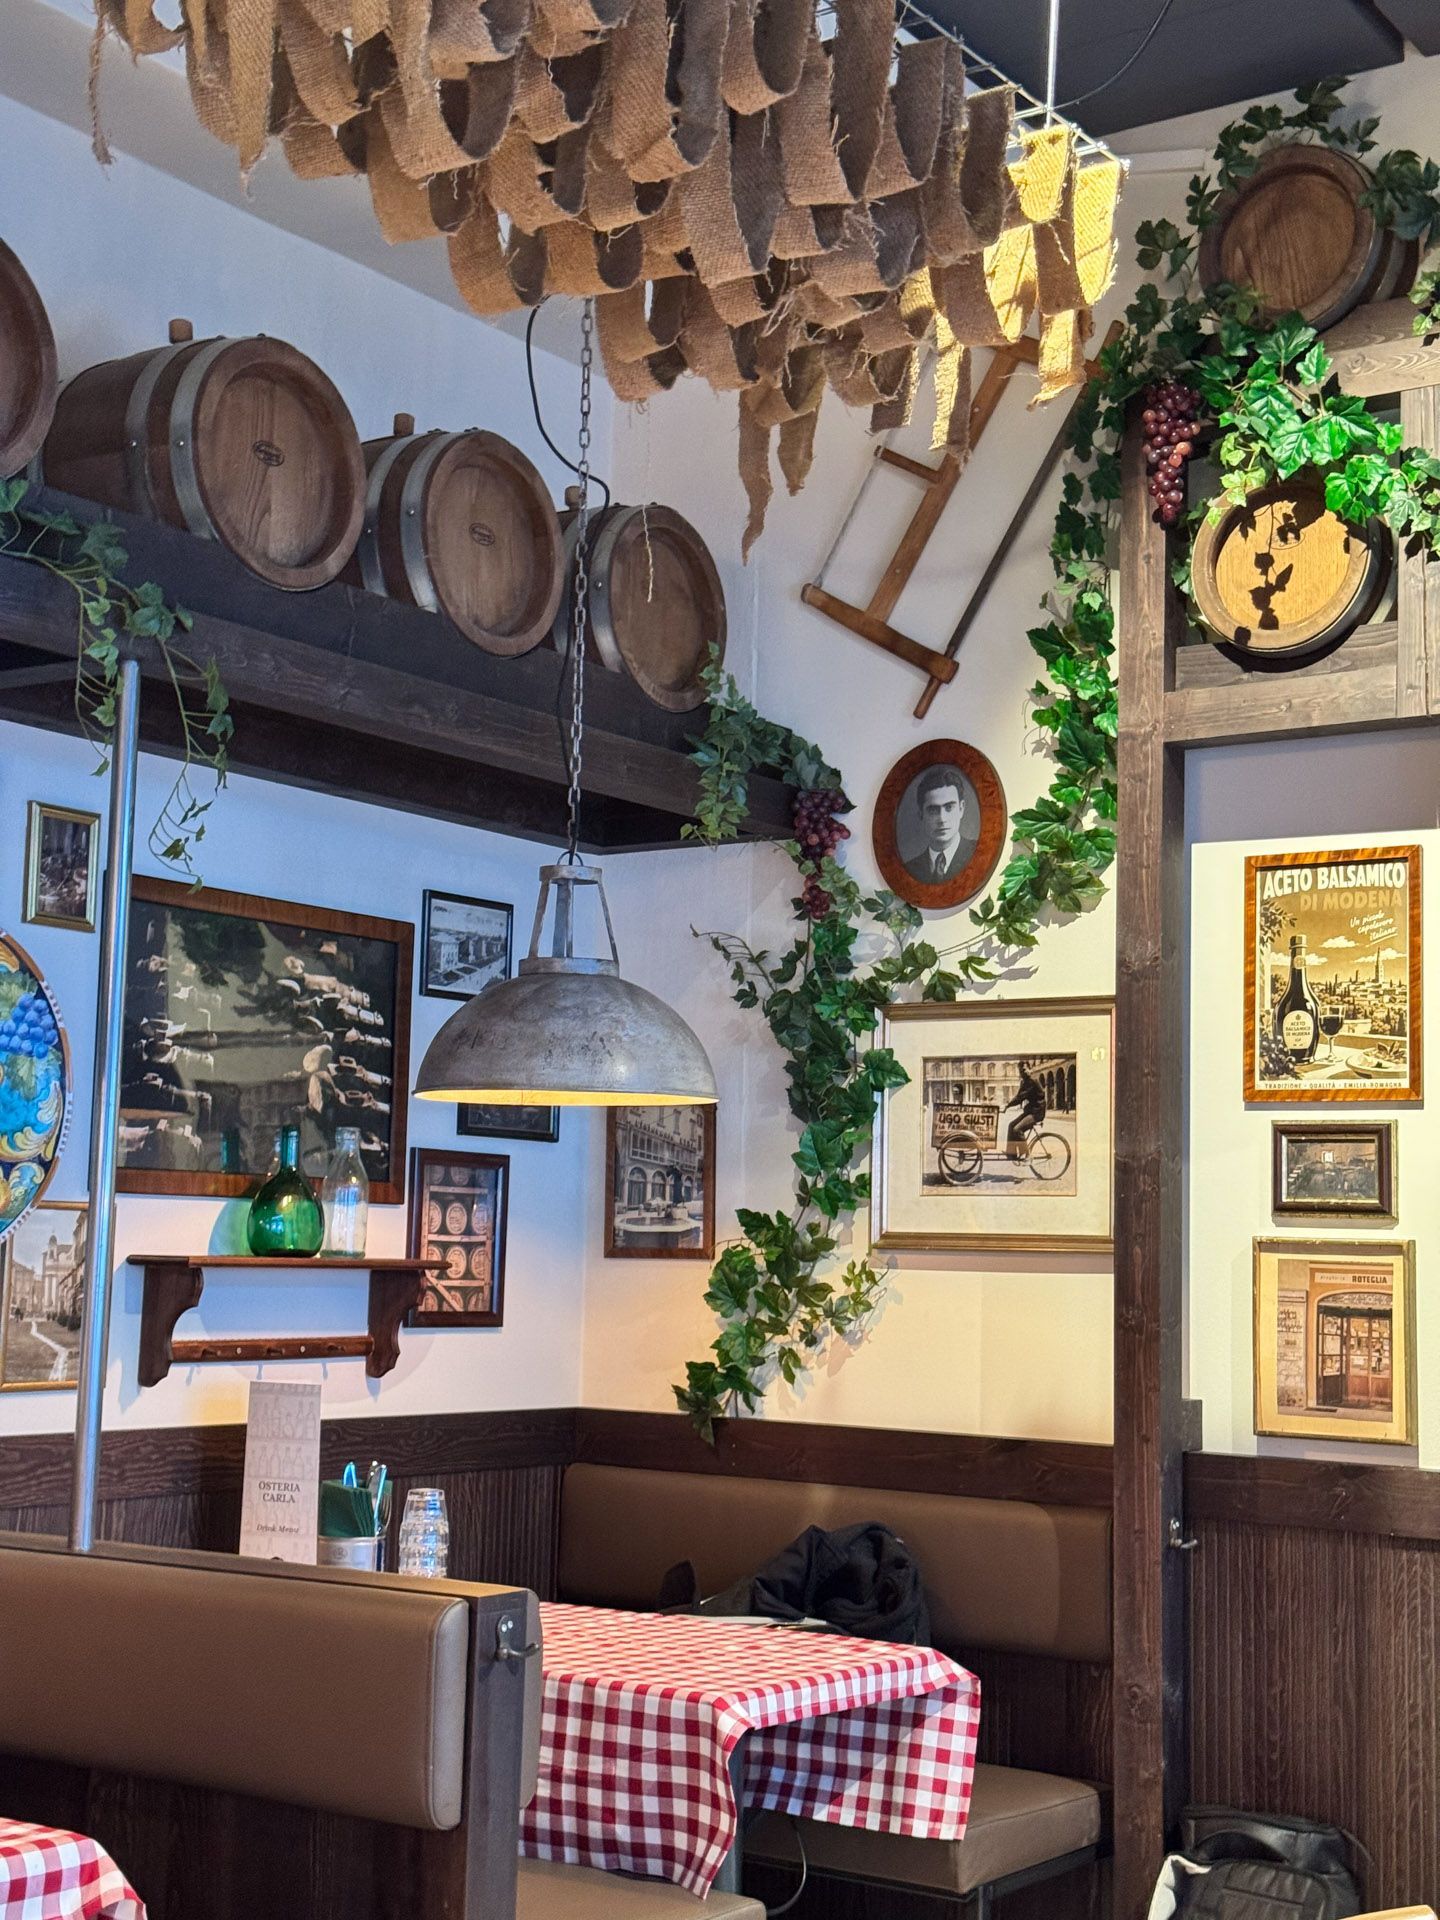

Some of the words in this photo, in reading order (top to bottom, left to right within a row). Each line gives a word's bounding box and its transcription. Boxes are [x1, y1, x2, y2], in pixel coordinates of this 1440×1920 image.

[1263, 868, 1313, 899] ACETO
[1317, 862, 1406, 890] BALSAMICO
[1300, 893, 1318, 911] DI
[1323, 889, 1403, 910] MODENA
[939, 1113, 961, 1124] UGO
[963, 1114, 994, 1126] GIUSTI
[1352, 1275, 1388, 1284] ROTEGLIA
[258, 1481, 300, 1492] OSTERIA
[263, 1493, 295, 1503] CARLA
[256, 1523, 276, 1532] Drink
[279, 1525, 300, 1533] Menu
